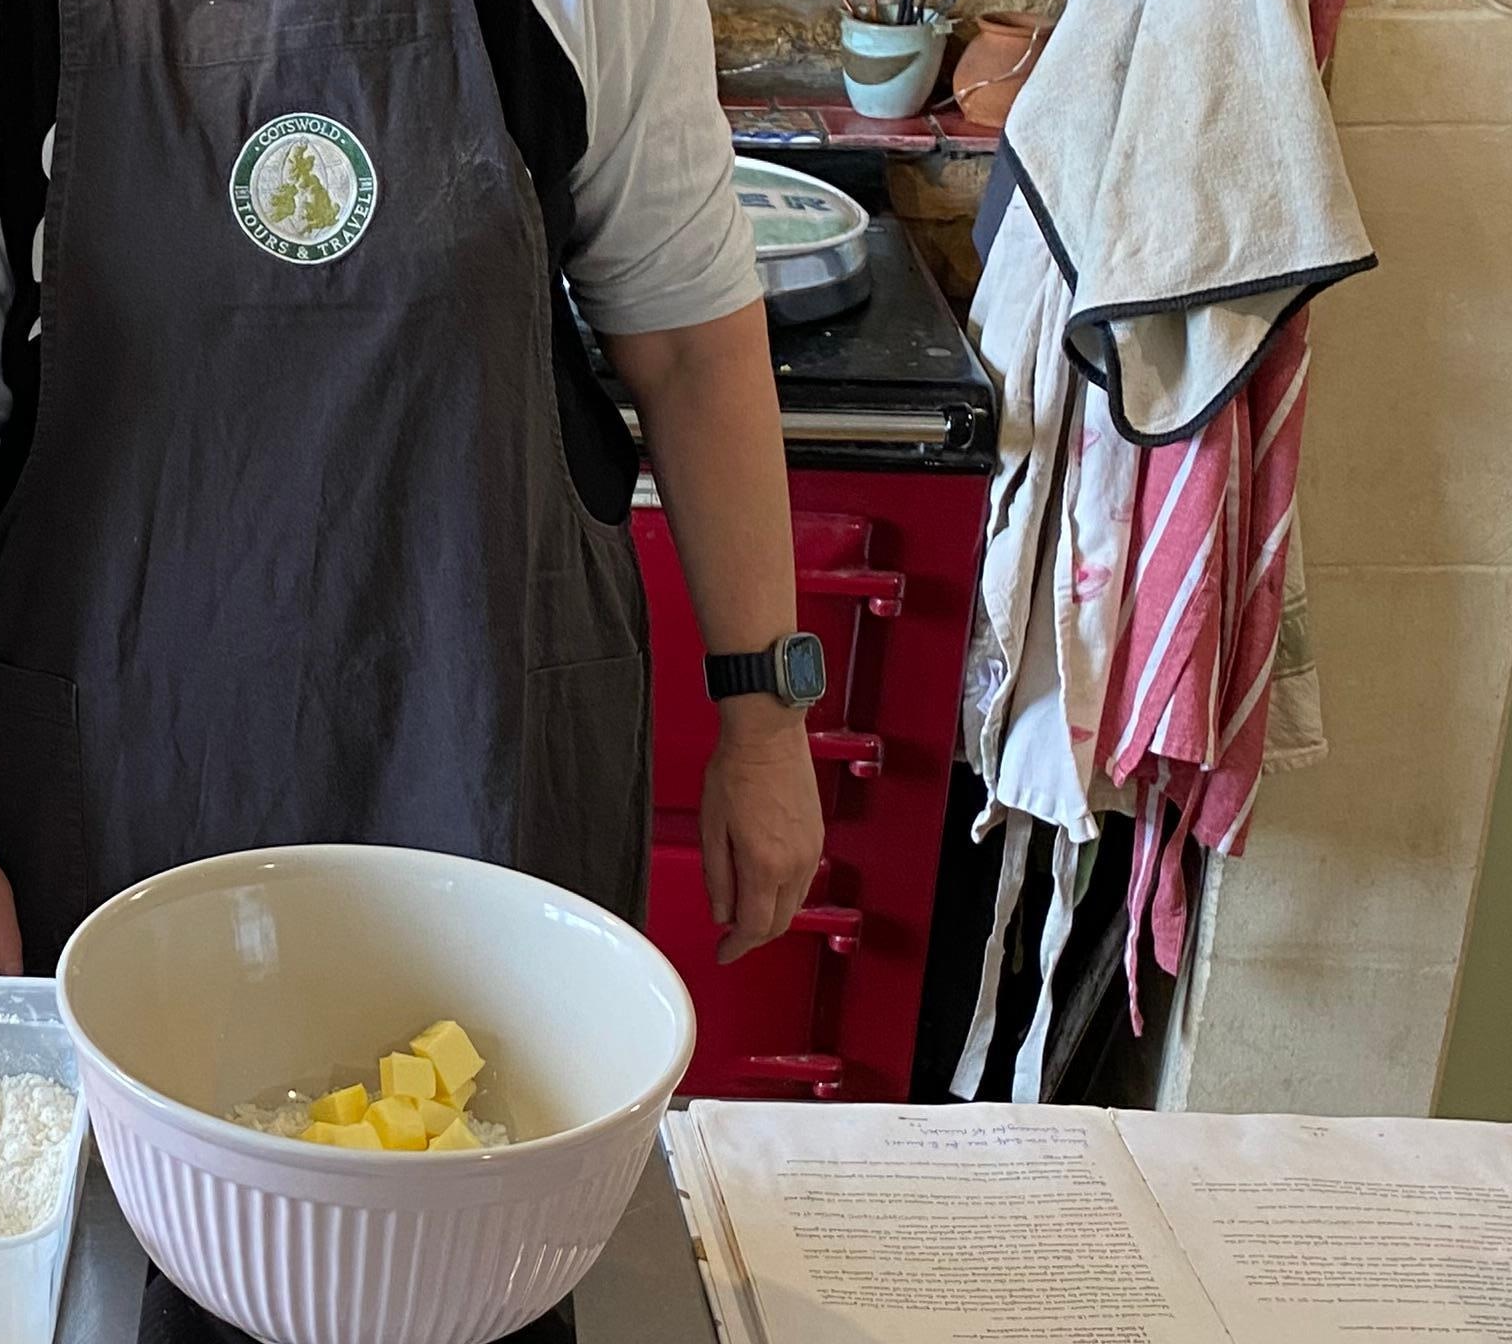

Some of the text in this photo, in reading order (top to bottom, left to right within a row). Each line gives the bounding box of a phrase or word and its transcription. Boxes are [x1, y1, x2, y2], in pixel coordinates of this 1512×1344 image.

[259, 118, 341, 146] COTSWOLD
[238, 193, 371, 260] TOURS & TRAVEL
